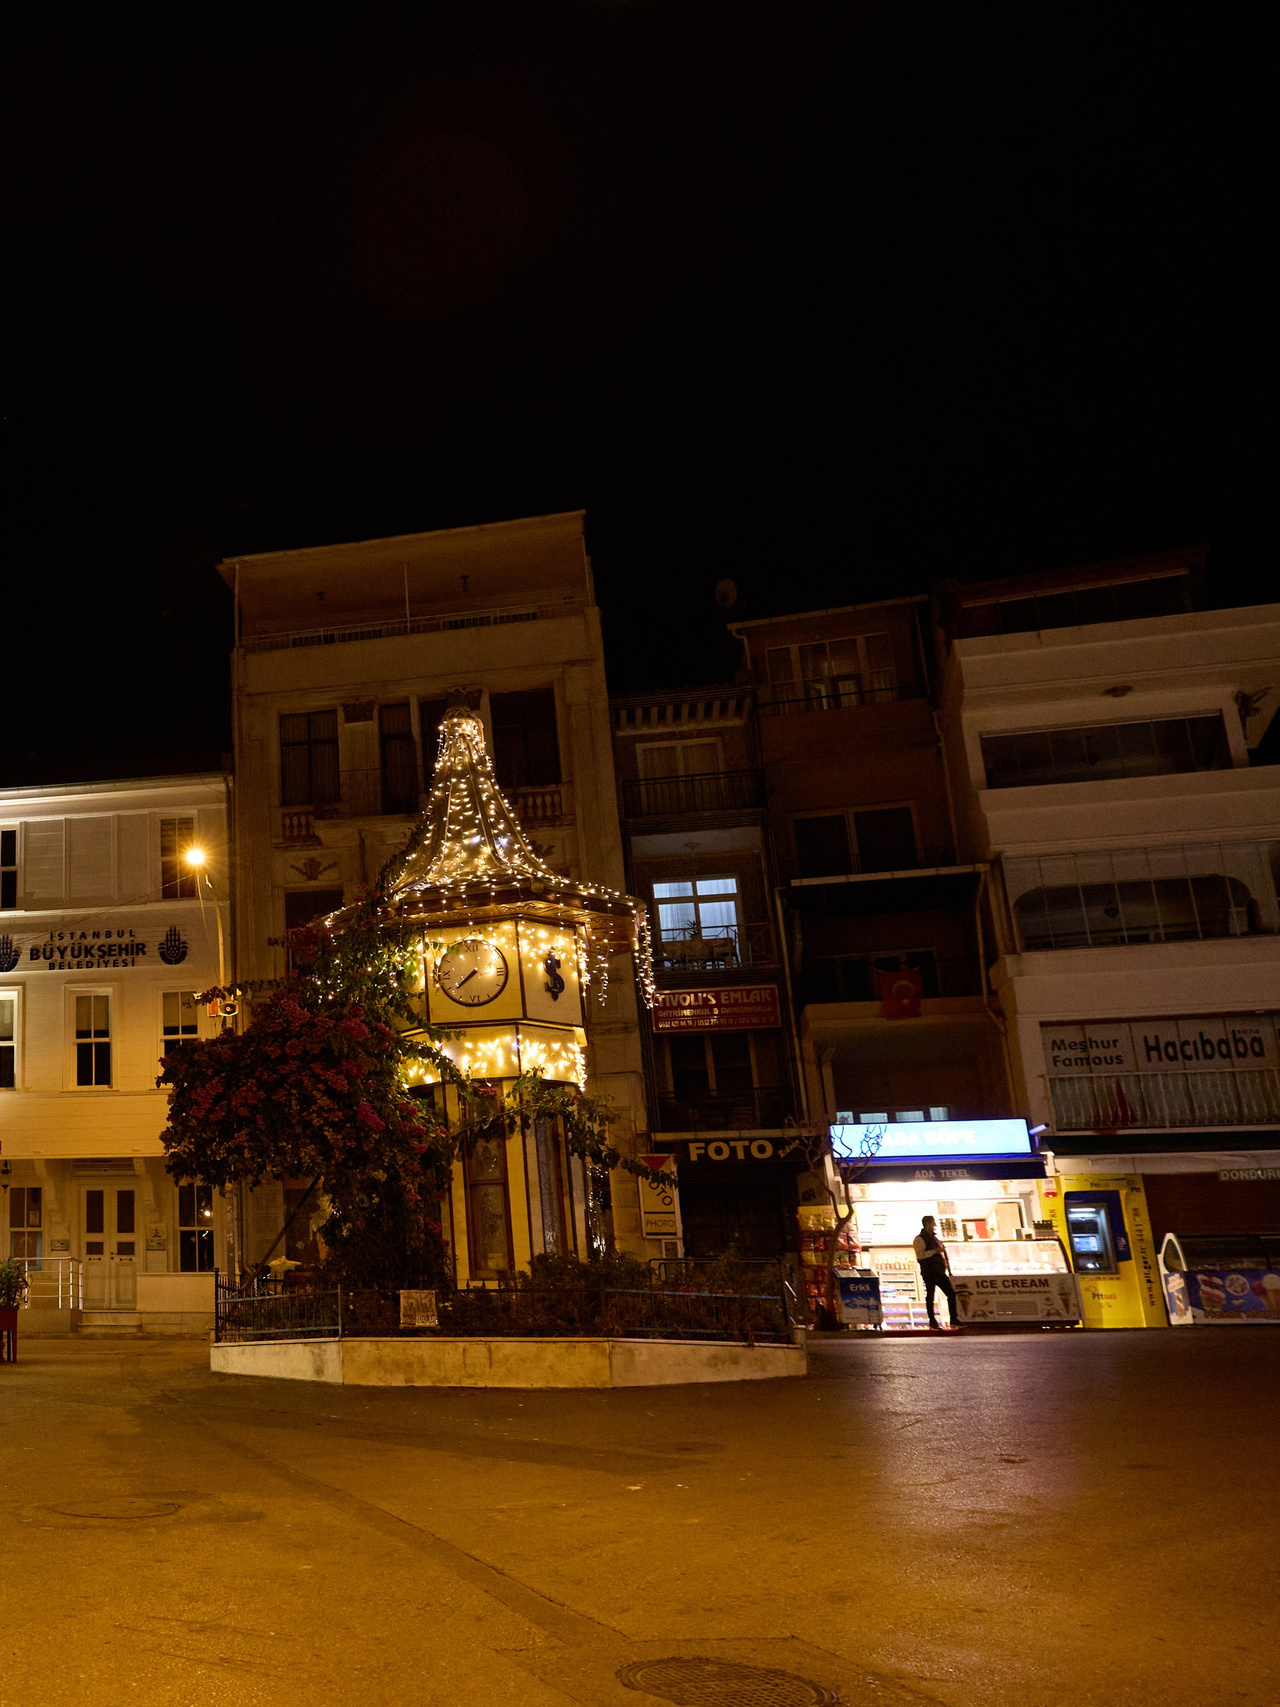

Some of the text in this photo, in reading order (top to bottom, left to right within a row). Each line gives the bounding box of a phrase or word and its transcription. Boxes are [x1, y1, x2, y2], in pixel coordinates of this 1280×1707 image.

[50, 929, 136, 941] İSTANBUL
[29, 940, 147, 961] BÜYÜKŞEHİR
[49, 958, 135, 970] BELEDİYESİ
[720, 990, 771, 1004] EMLAK
[1052, 1029, 1265, 1063] Meşhur Hacıbaba
[1053, 1054, 1124, 1067] Famous
[881, 1131, 922, 1147] ADA
[688, 1139, 774, 1162] FOTO
[915, 1169, 969, 1178] ADA TEKEL
[646, 1219, 674, 1227] PHOTO
[975, 1278, 1050, 1289] ICE CREAM
